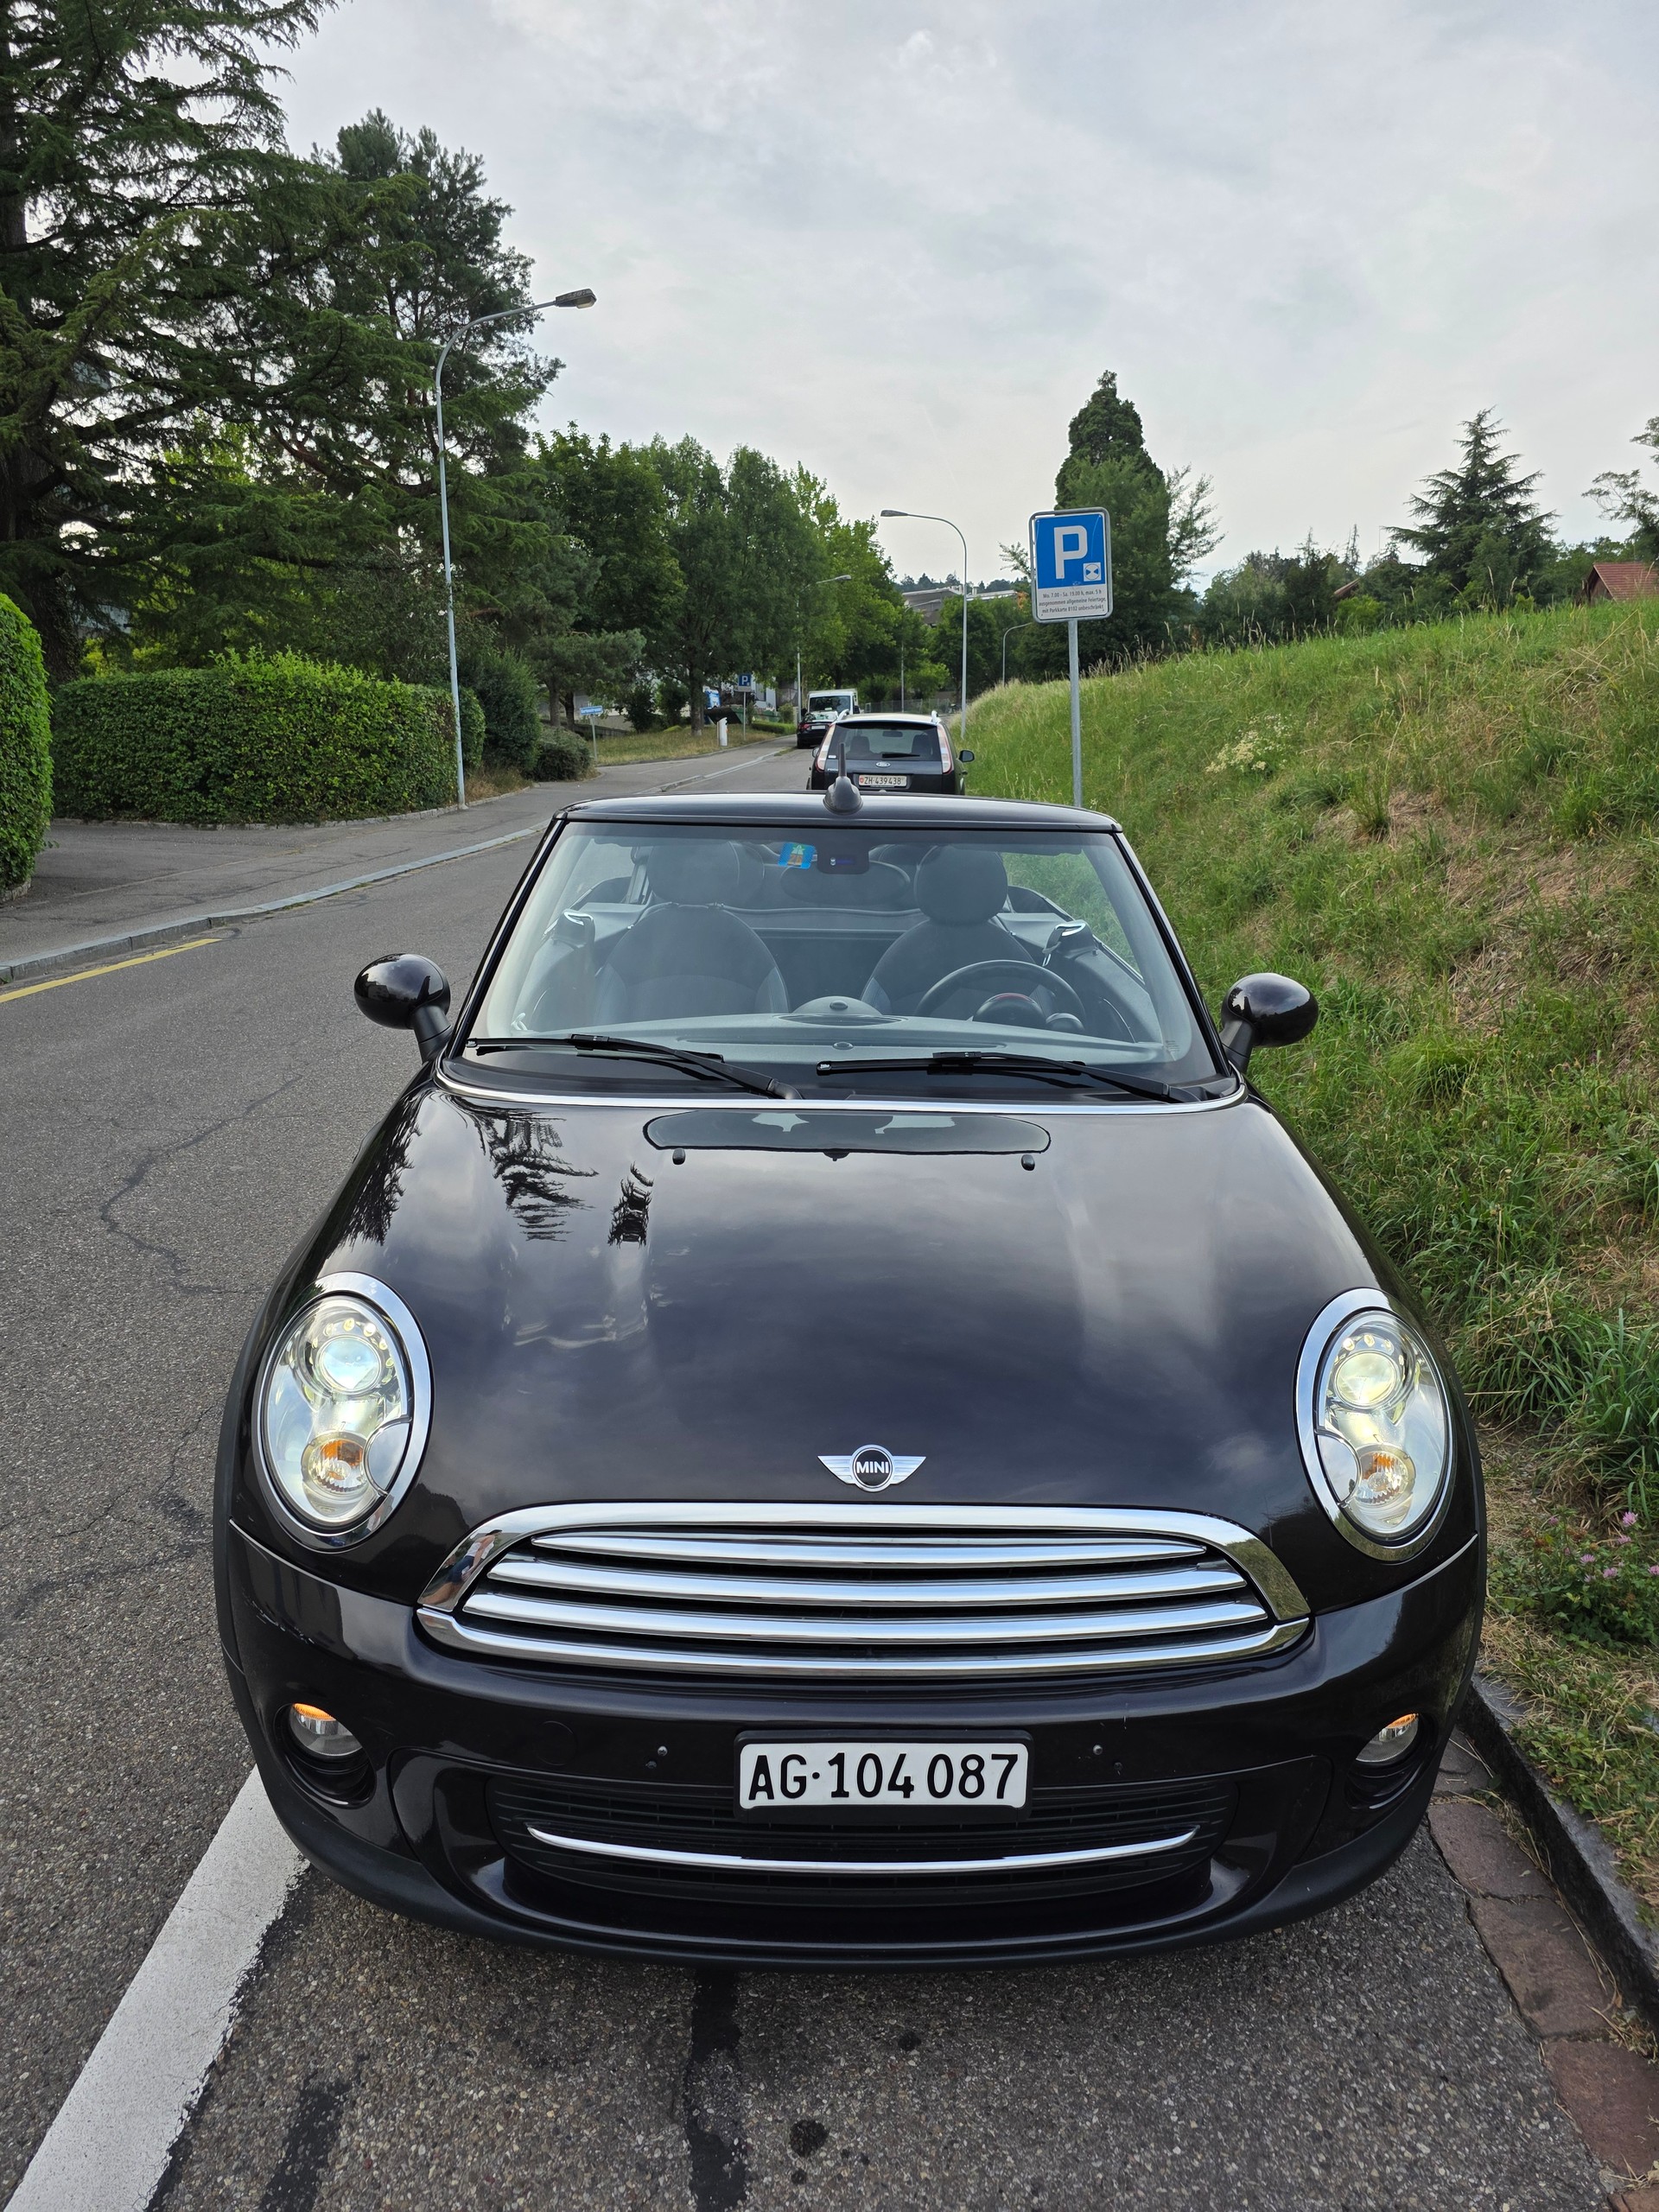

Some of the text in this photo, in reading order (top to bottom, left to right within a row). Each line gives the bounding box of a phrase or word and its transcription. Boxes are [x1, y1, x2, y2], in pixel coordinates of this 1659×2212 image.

[1054, 525, 1088, 579] P
[741, 675, 748, 685] P
[856, 1461, 889, 1474] MINI
